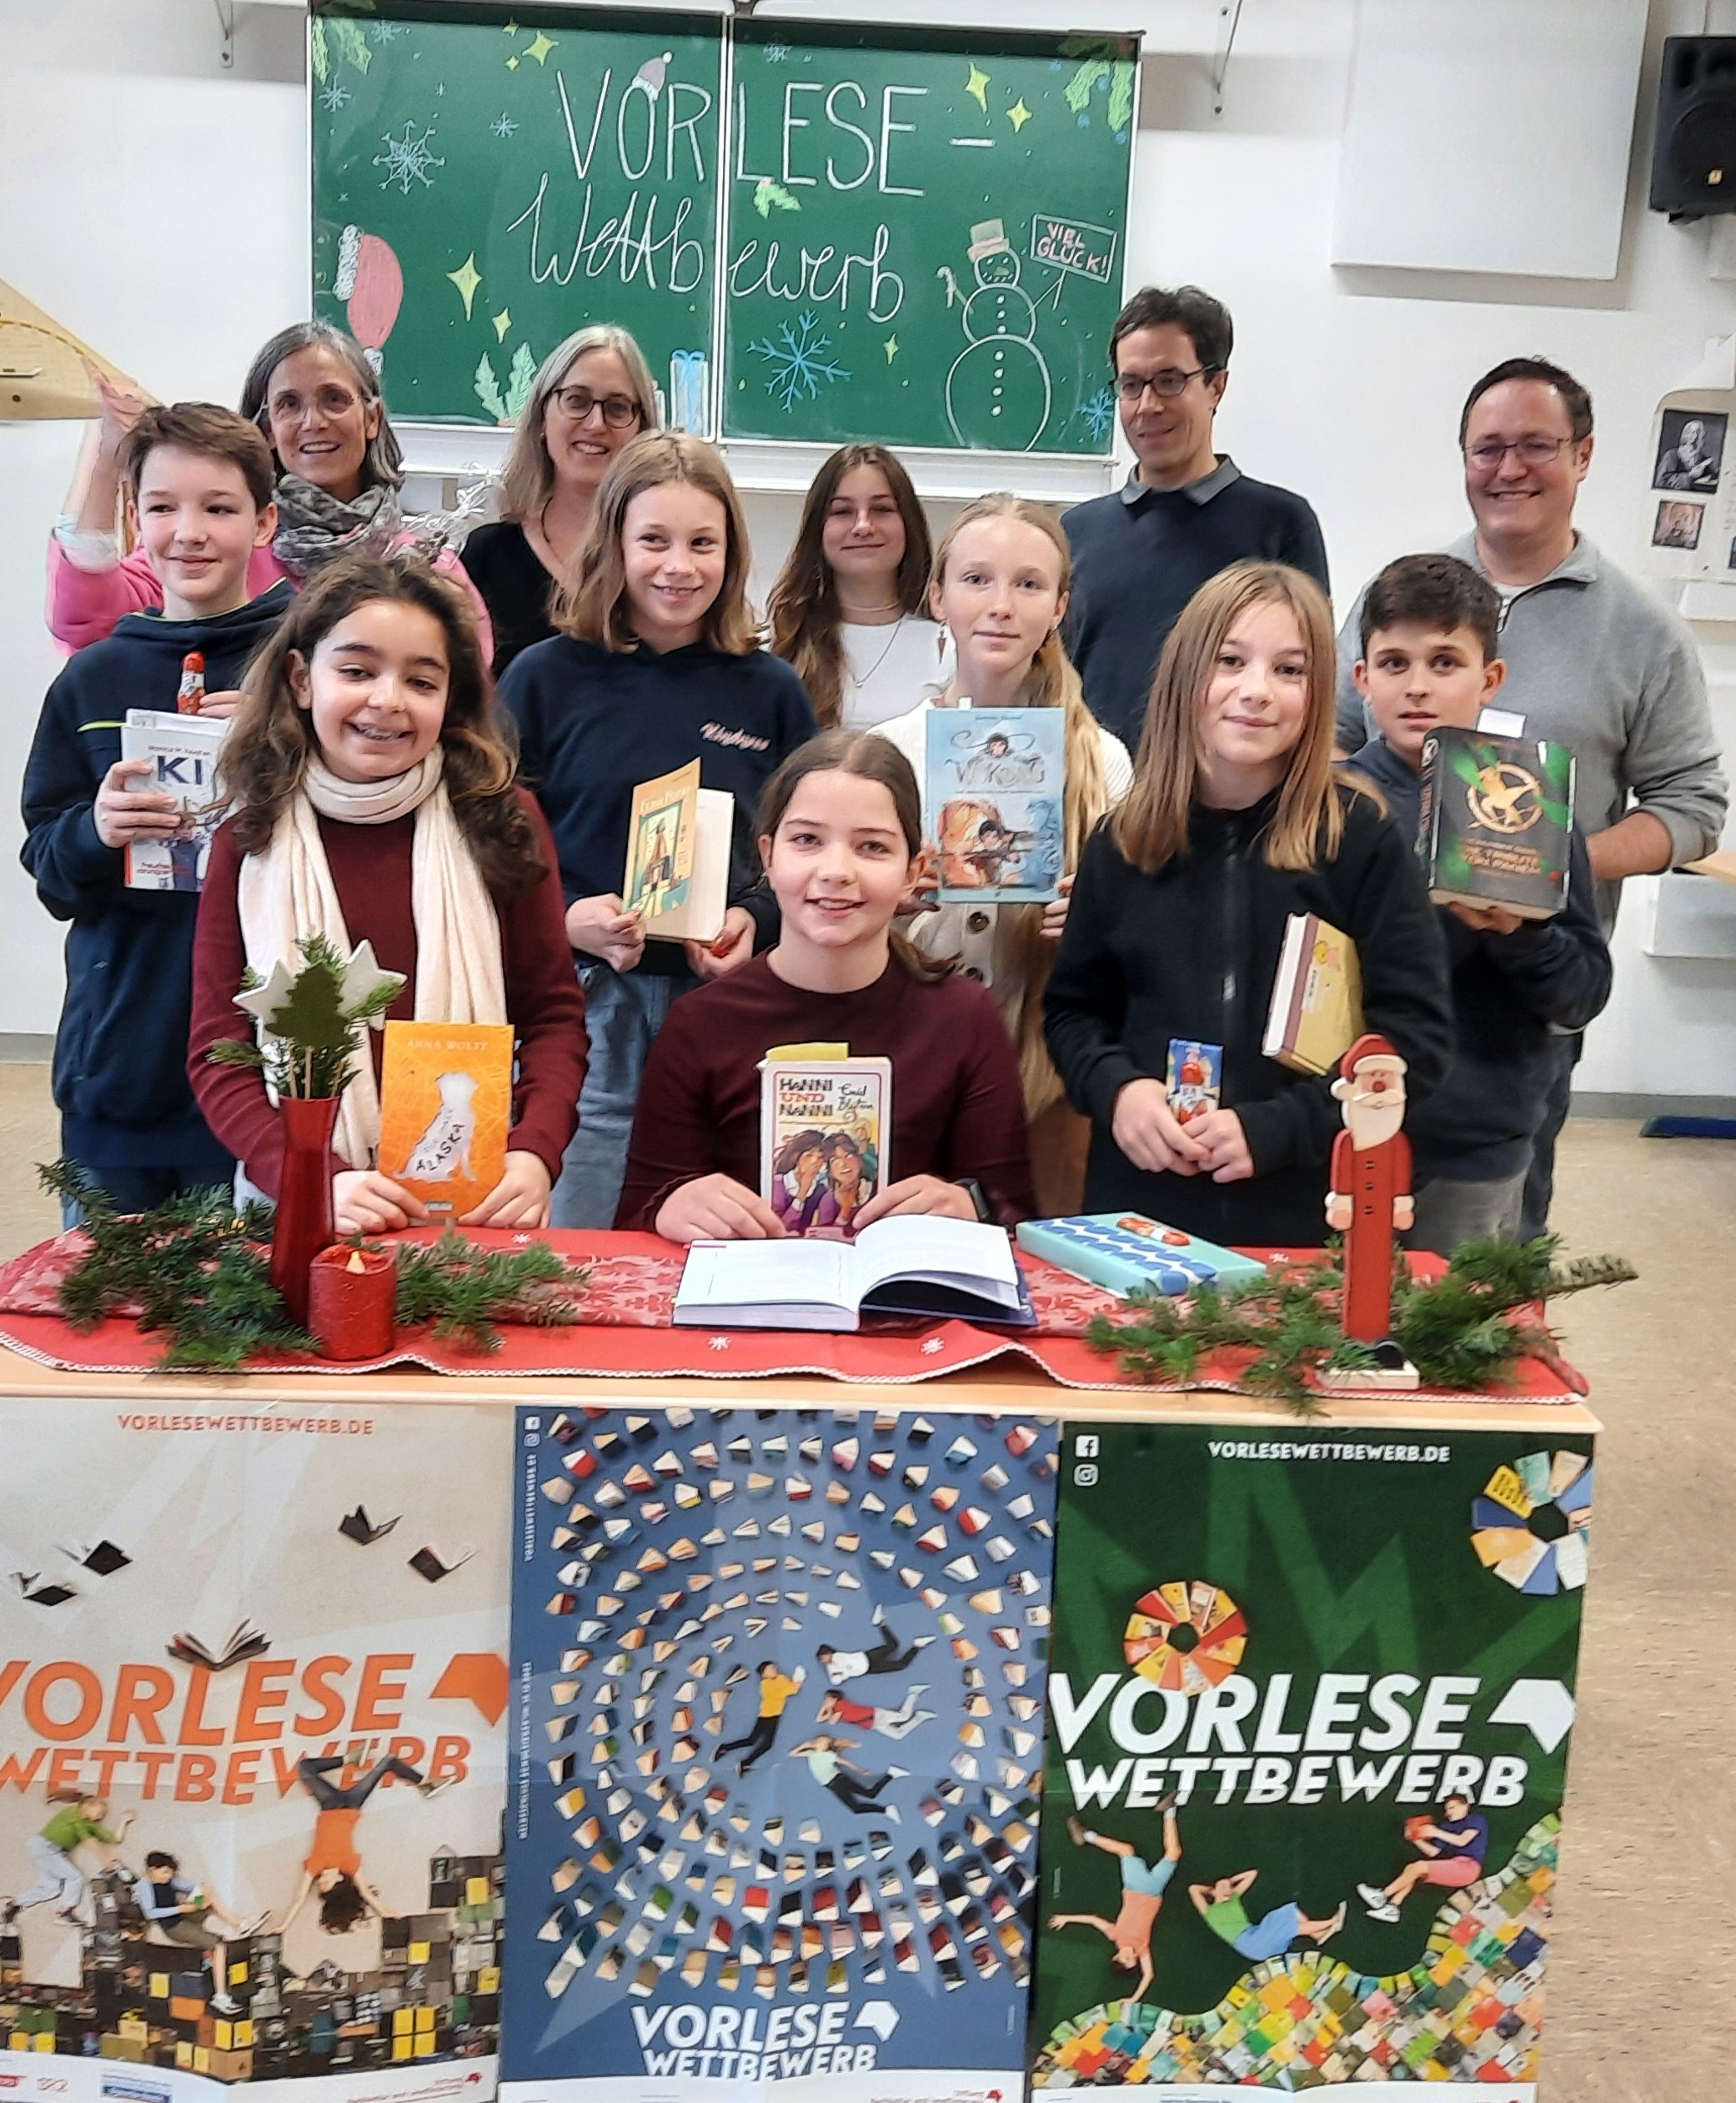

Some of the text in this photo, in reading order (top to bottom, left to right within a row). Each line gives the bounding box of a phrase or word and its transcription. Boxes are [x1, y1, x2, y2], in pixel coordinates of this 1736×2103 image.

[1047, 222, 1086, 249] VIEL
[157, 754, 203, 785] KI
[779, 1092, 825, 1103] UND
[117, 1414, 374, 1436] VORLESEWETTBEWERB.DE
[1207, 1441, 1451, 1463] VORLESEWETTBEWERB.DE
[1047, 1671, 1483, 1754] VORLESE
[1065, 1754, 1529, 1811] WETTBEWERB
[630, 2000, 850, 2055] VORLESE
[642, 2043, 870, 2083] WETTBEWERB
